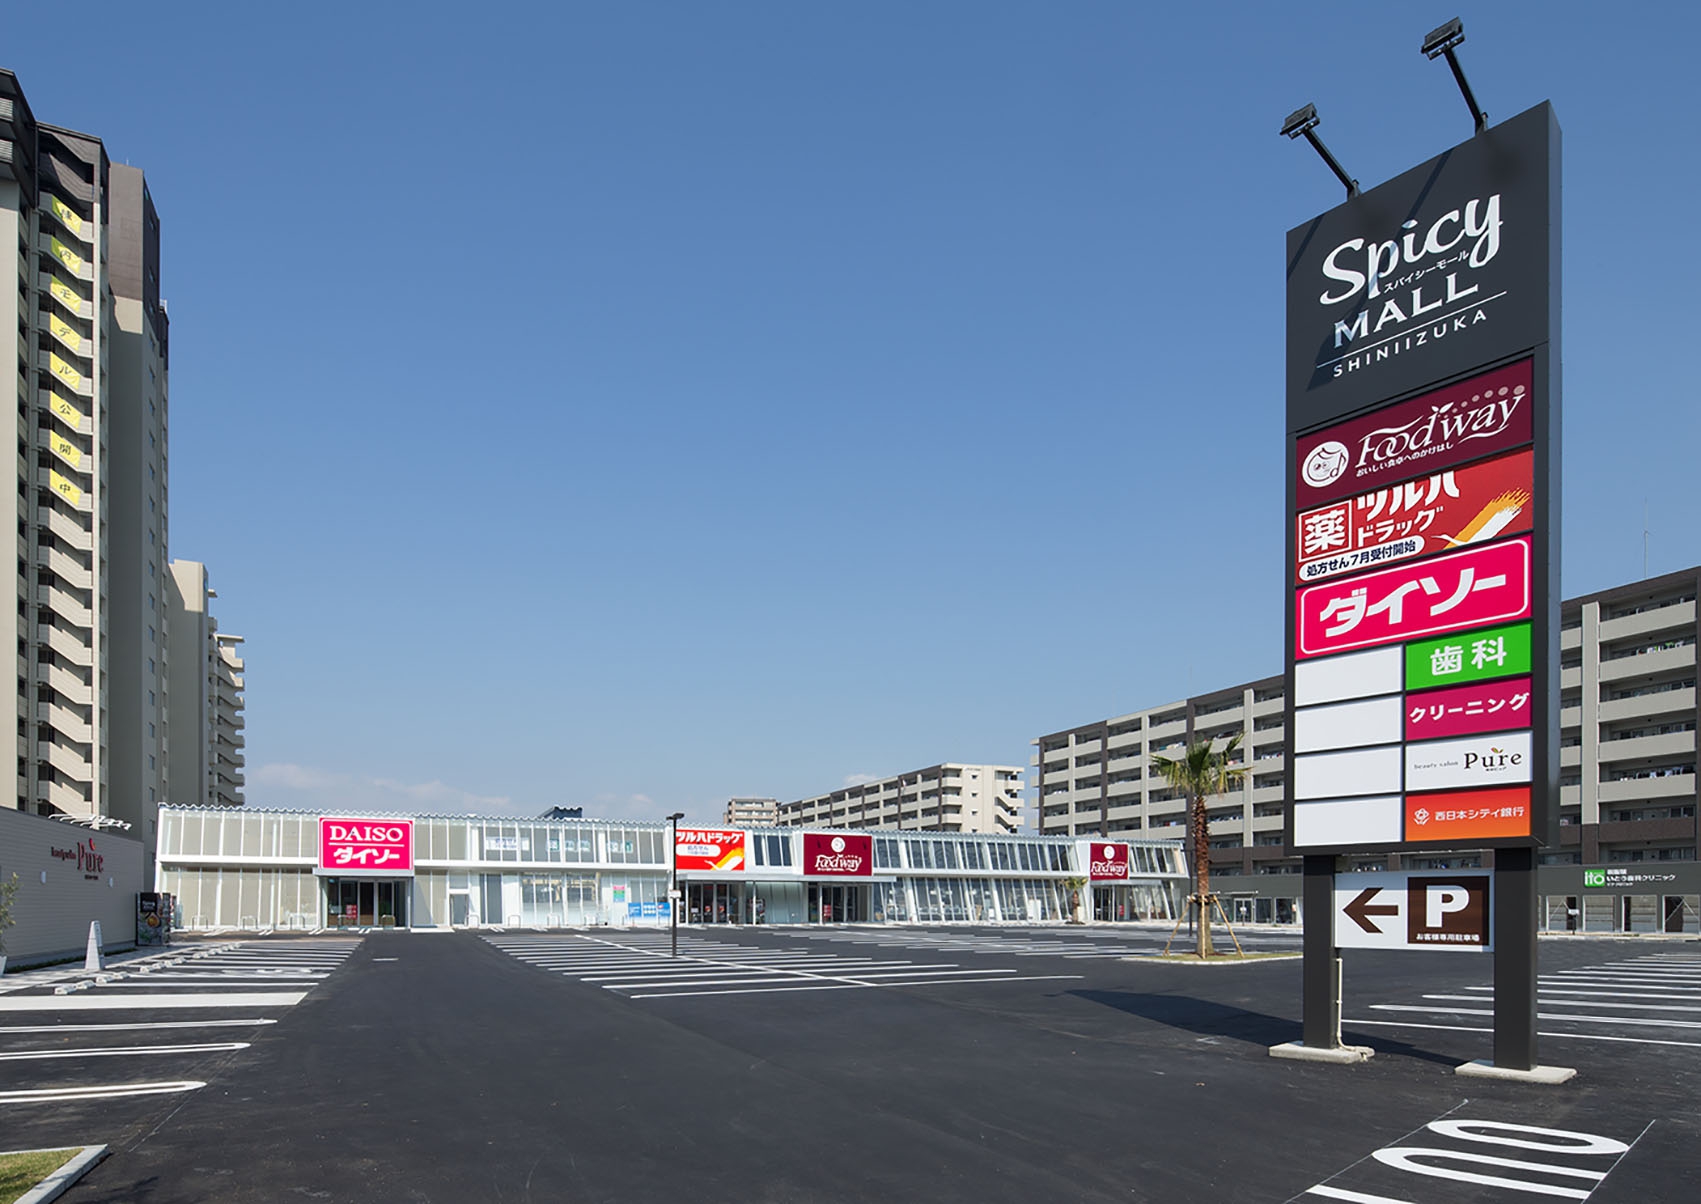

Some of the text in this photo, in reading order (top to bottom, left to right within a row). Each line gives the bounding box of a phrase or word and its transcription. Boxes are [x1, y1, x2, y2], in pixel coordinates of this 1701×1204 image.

[1320, 194, 1503, 305] Spicy
[1383, 250, 1470, 294] スパイシーモール
[1333, 272, 1479, 348] MALL
[1333, 309, 1487, 377] SHINIIZUKA
[1354, 394, 1526, 469] Foodway
[1304, 508, 1347, 555] 薬
[1357, 506, 1444, 548] ドラッグ
[1319, 567, 1506, 638] ダイソー
[1430, 636, 1508, 676] 歯科
[1409, 691, 1530, 723] クリーニング
[1464, 752, 1522, 770] Pure
[329, 825, 403, 842] DAISO
[1435, 806, 1525, 821] 西日本シティ銀行
[77, 841, 104, 873] Pure
[333, 847, 400, 865] ダイソー
[1425, 885, 1470, 928] P
